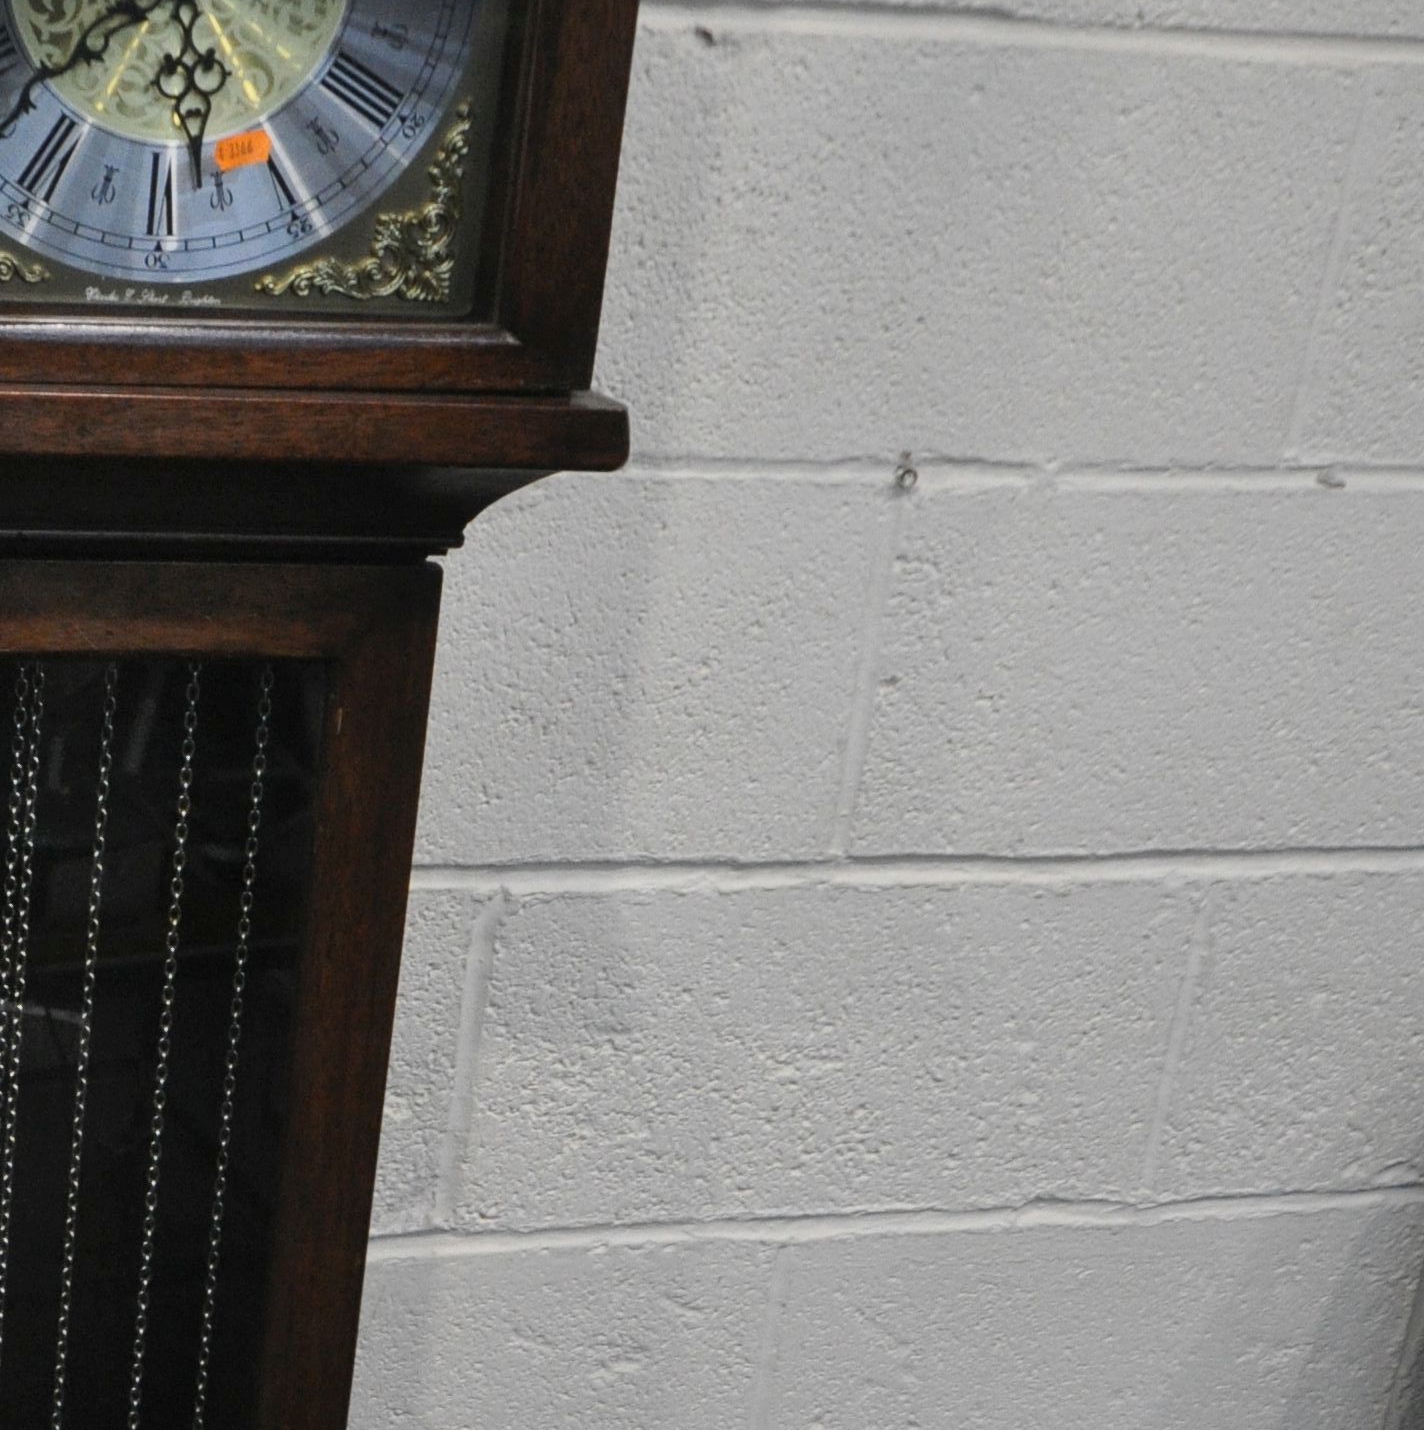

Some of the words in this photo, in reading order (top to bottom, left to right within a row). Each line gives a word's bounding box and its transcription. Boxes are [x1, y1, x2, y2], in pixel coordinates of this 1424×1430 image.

[321, 51, 404, 129] IIII
[402, 111, 425, 140] 20
[16, 110, 83, 204] VII
[146, 151, 174, 236] VI
[5, 203, 31, 228] 35
[286, 221, 314, 239] 25
[144, 252, 171, 269] 30
